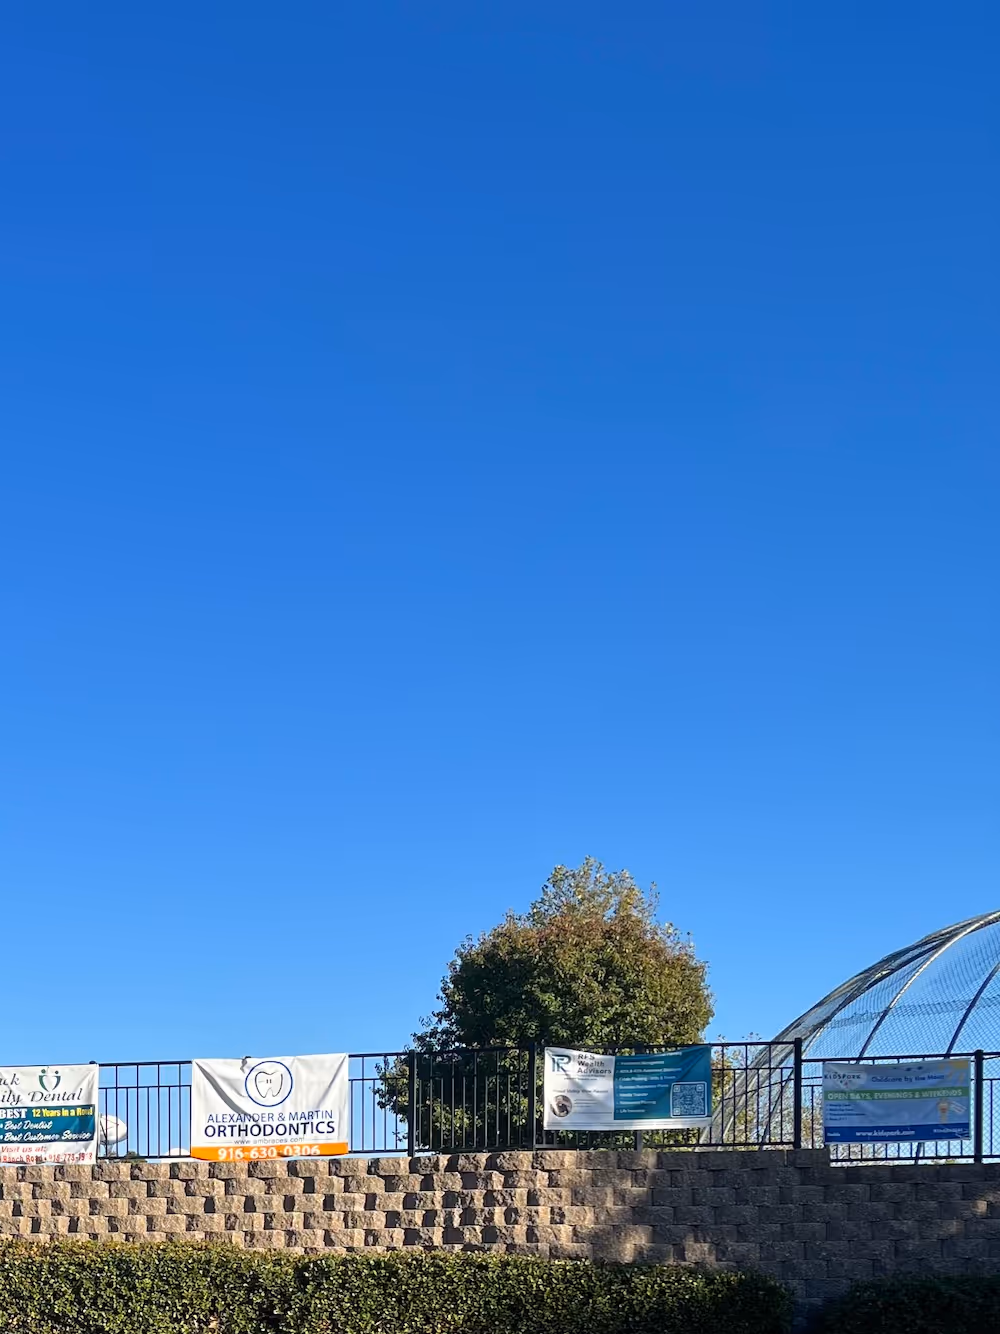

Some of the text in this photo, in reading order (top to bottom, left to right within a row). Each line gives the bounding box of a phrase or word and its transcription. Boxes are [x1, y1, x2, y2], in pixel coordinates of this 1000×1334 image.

[904, 1075, 913, 1083] by
[27, 1088, 83, 1103] Dental
[827, 1092, 848, 1100] OPEN
[874, 1091, 912, 1100] EVENINGS
[921, 1089, 962, 1098] WEEKENDS
[32, 1109, 41, 1117] 12
[42, 1108, 61, 1117] Years
[207, 1109, 333, 1123] ALEXANDER & MARTIN
[4, 1120, 53, 1130] Best Dentist
[204, 1120, 335, 1138] ORTHODONTICS
[4, 1130, 92, 1142] Best Customer Service
[218, 1145, 321, 1160] 916-630-0306
